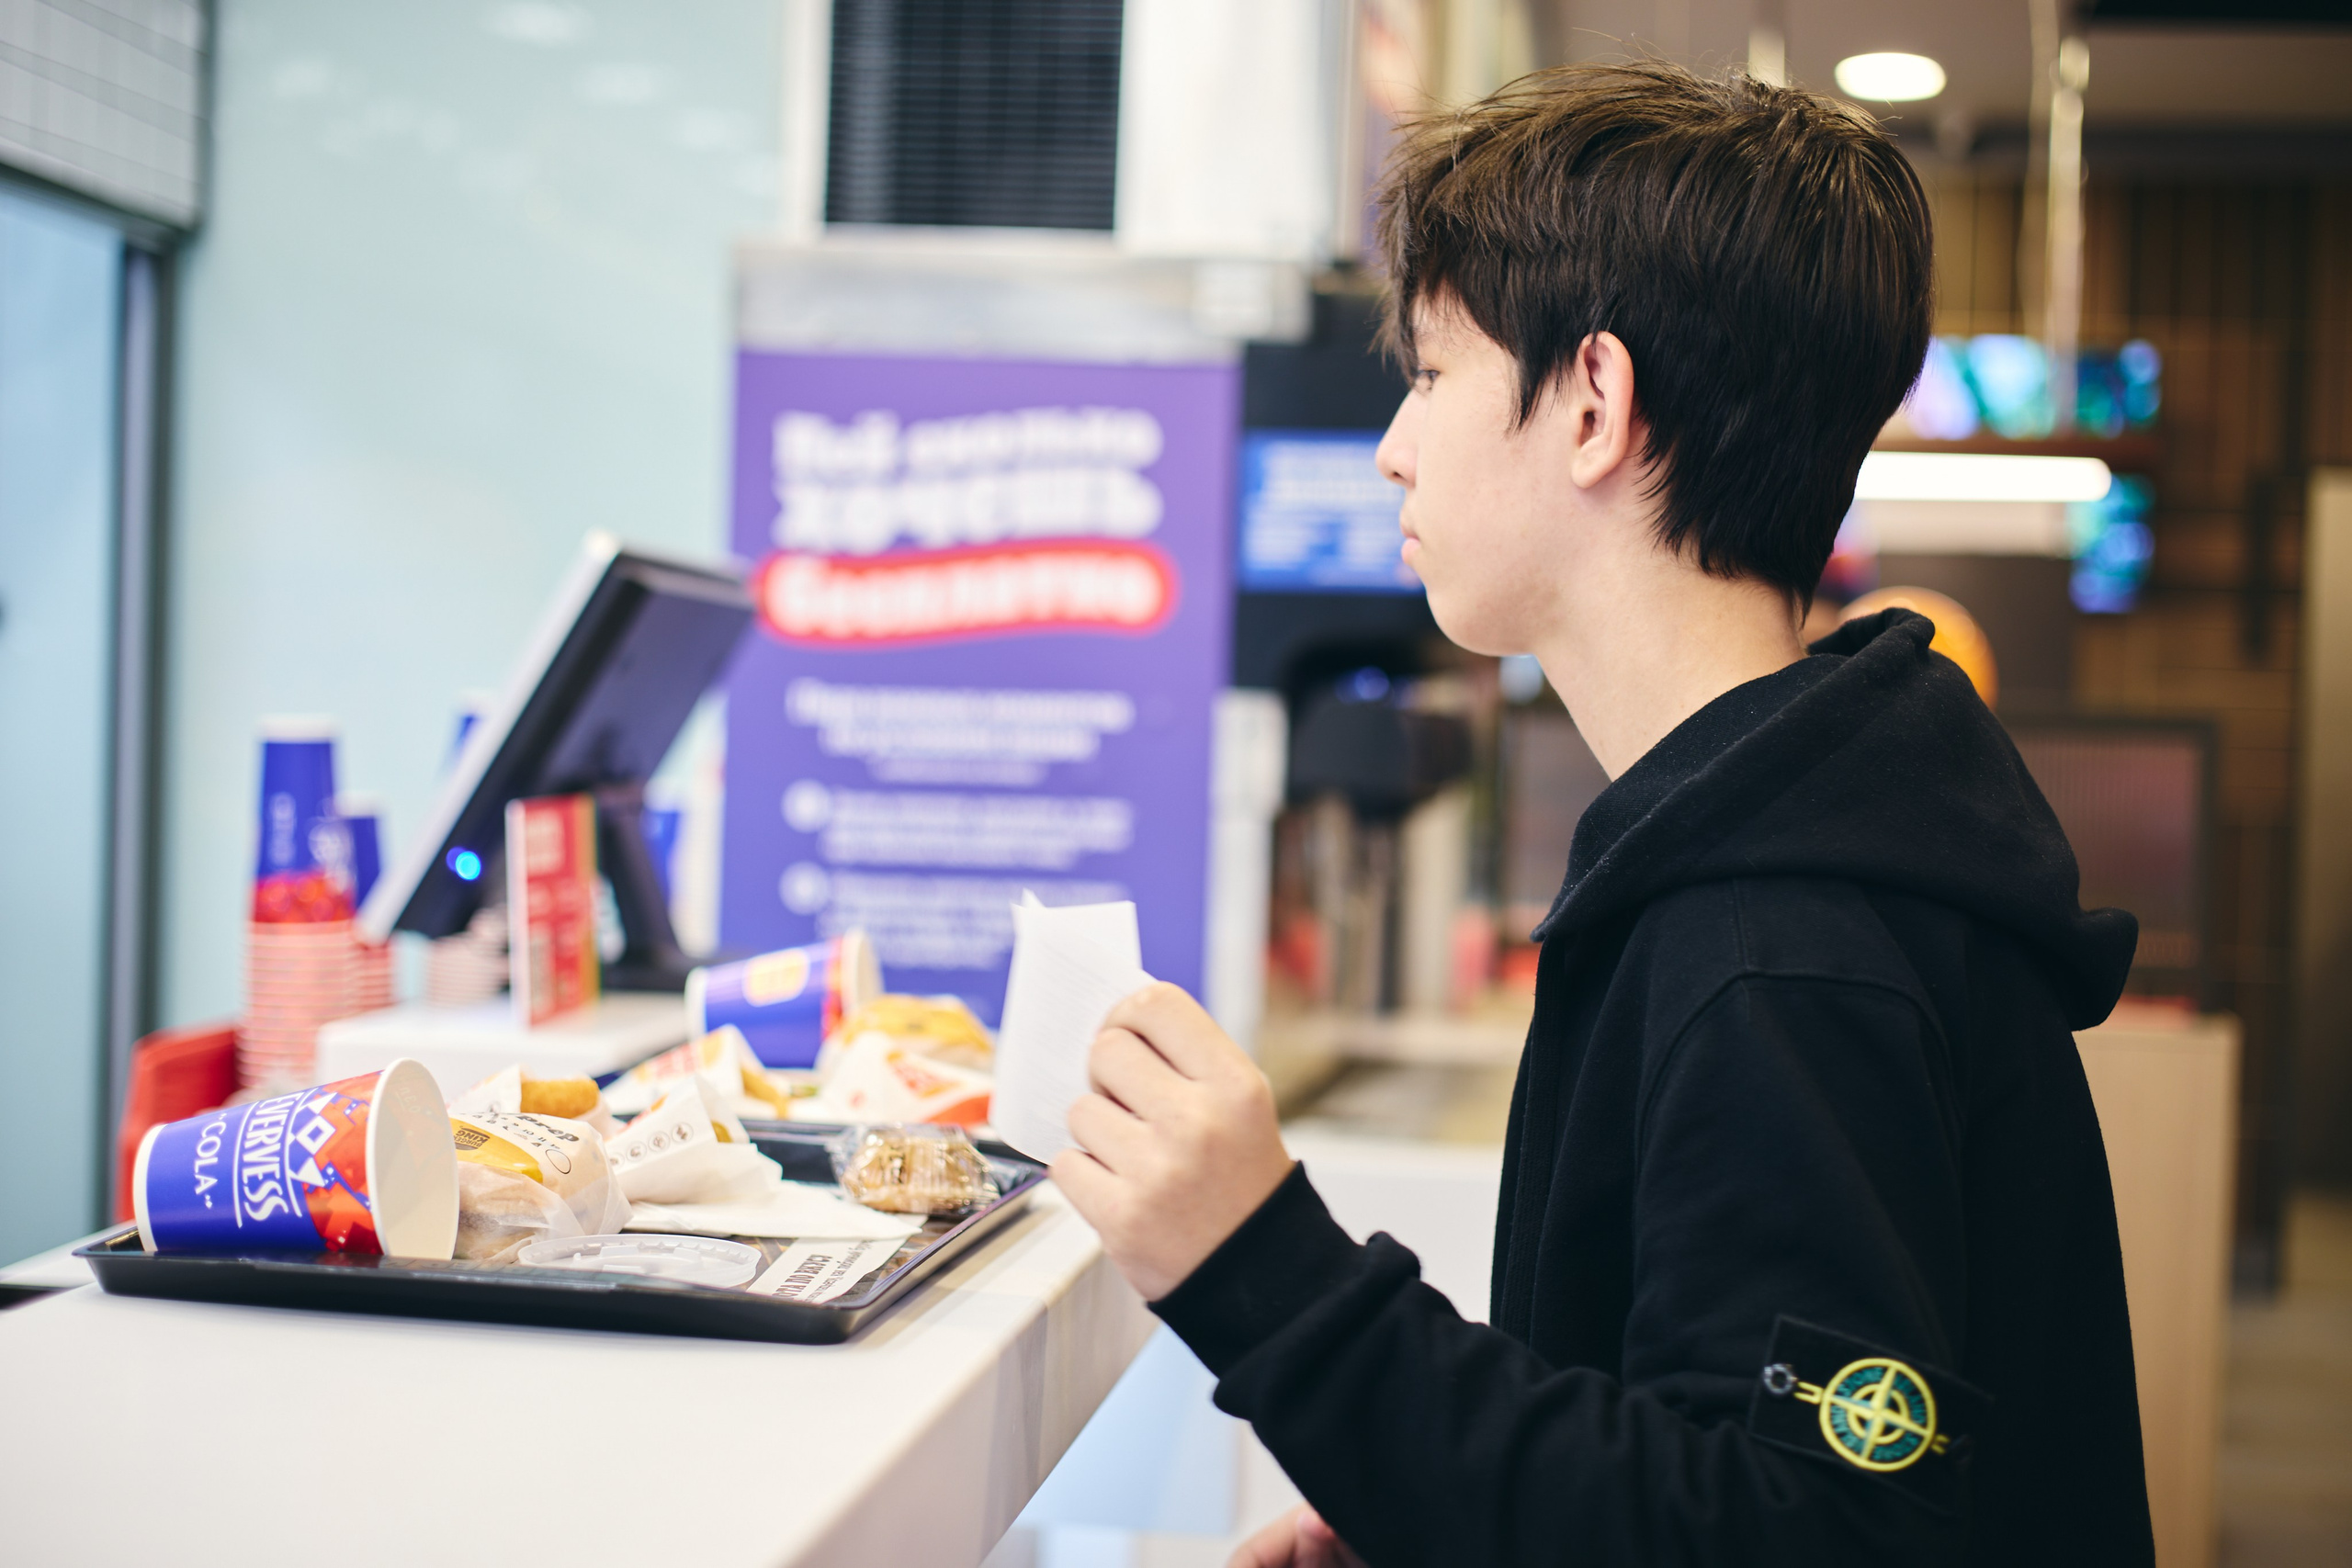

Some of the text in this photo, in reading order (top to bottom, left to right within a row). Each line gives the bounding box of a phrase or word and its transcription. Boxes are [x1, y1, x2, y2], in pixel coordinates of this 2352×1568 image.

[456, 1130, 490, 1144] KING
[195, 1122, 227, 1195] COLA
[785, 1275, 815, 1284] ПО
